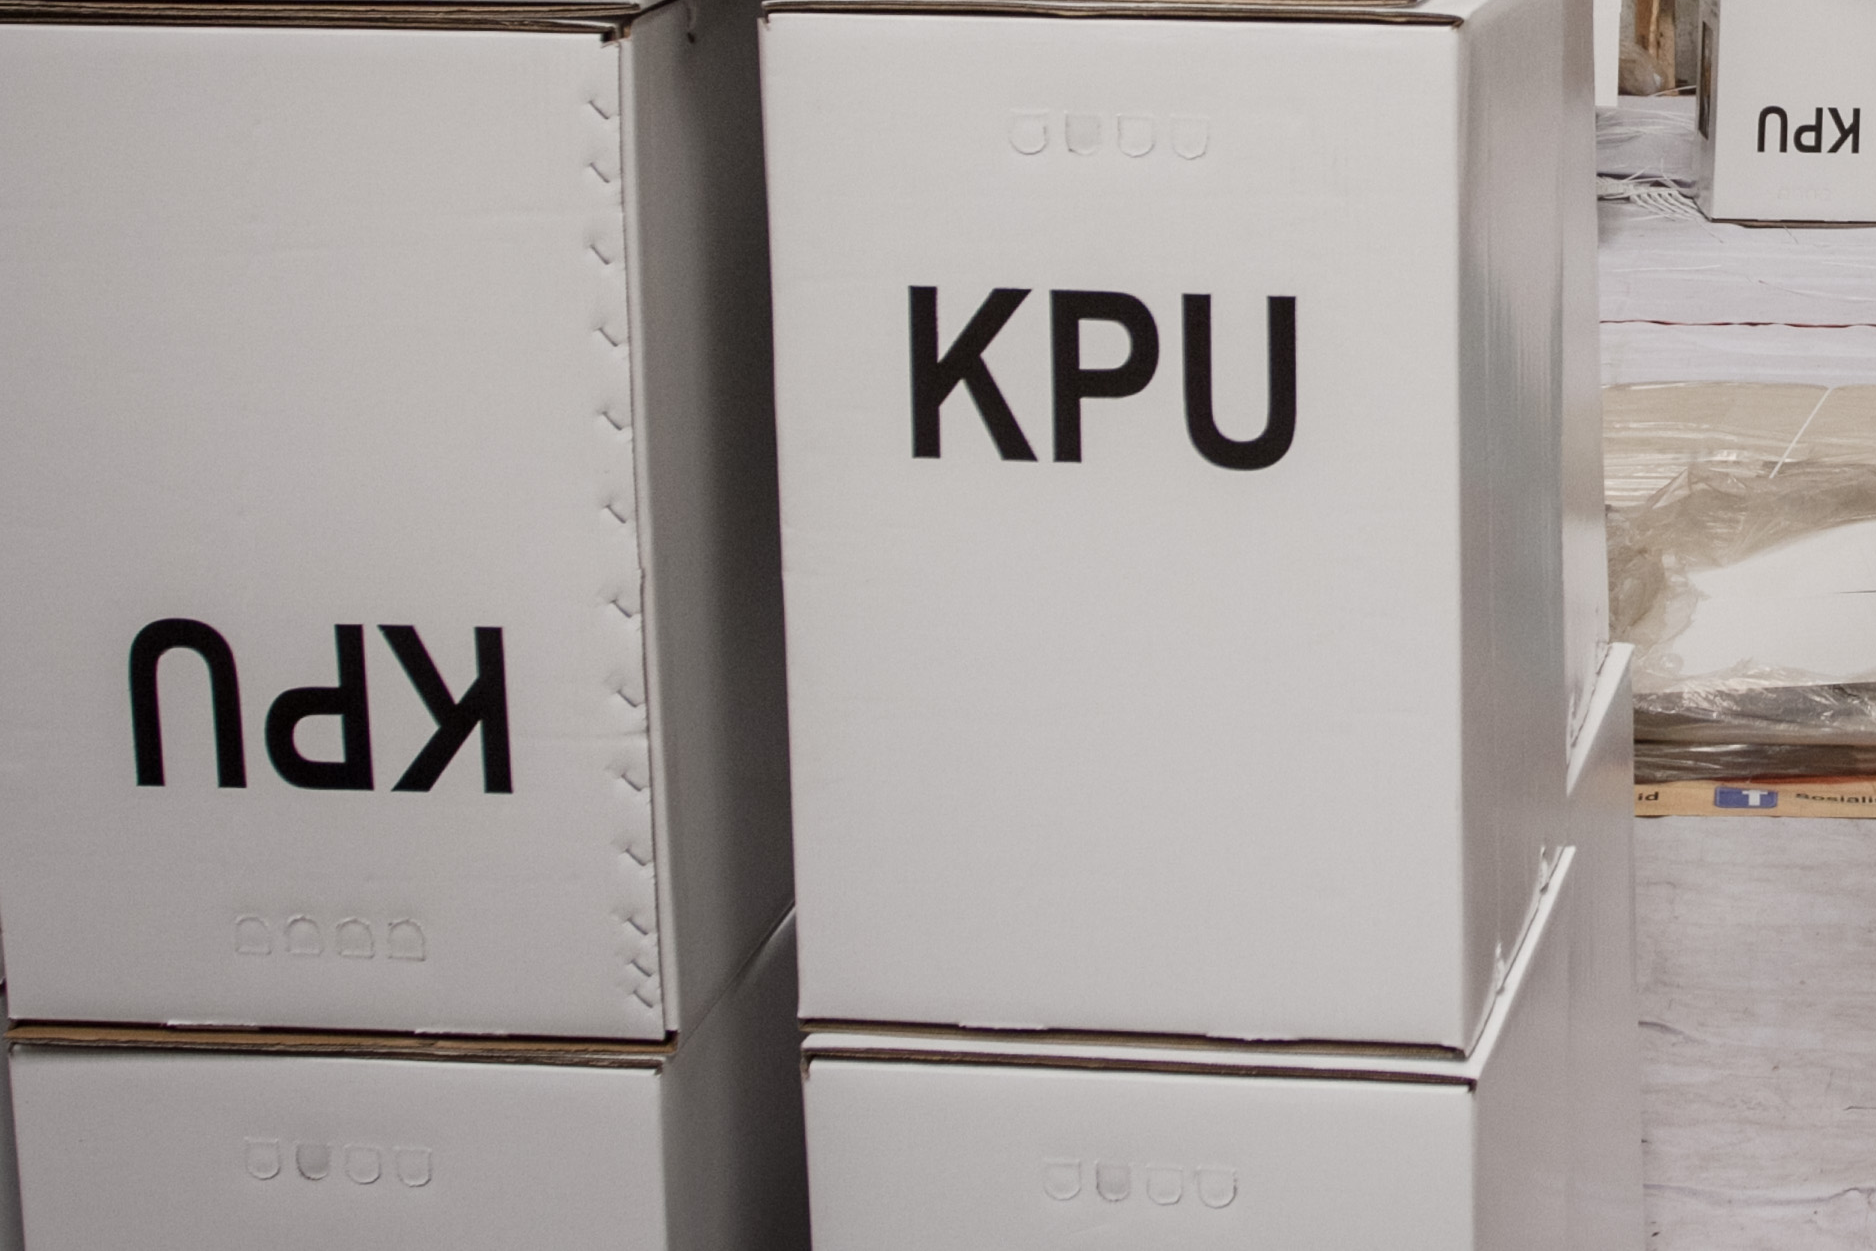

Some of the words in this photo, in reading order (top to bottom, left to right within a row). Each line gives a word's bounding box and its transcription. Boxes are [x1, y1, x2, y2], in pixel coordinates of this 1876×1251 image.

[1758, 106, 1860, 153] KPU
[909, 286, 1296, 470] KPU
[129, 618, 512, 793] KPU
